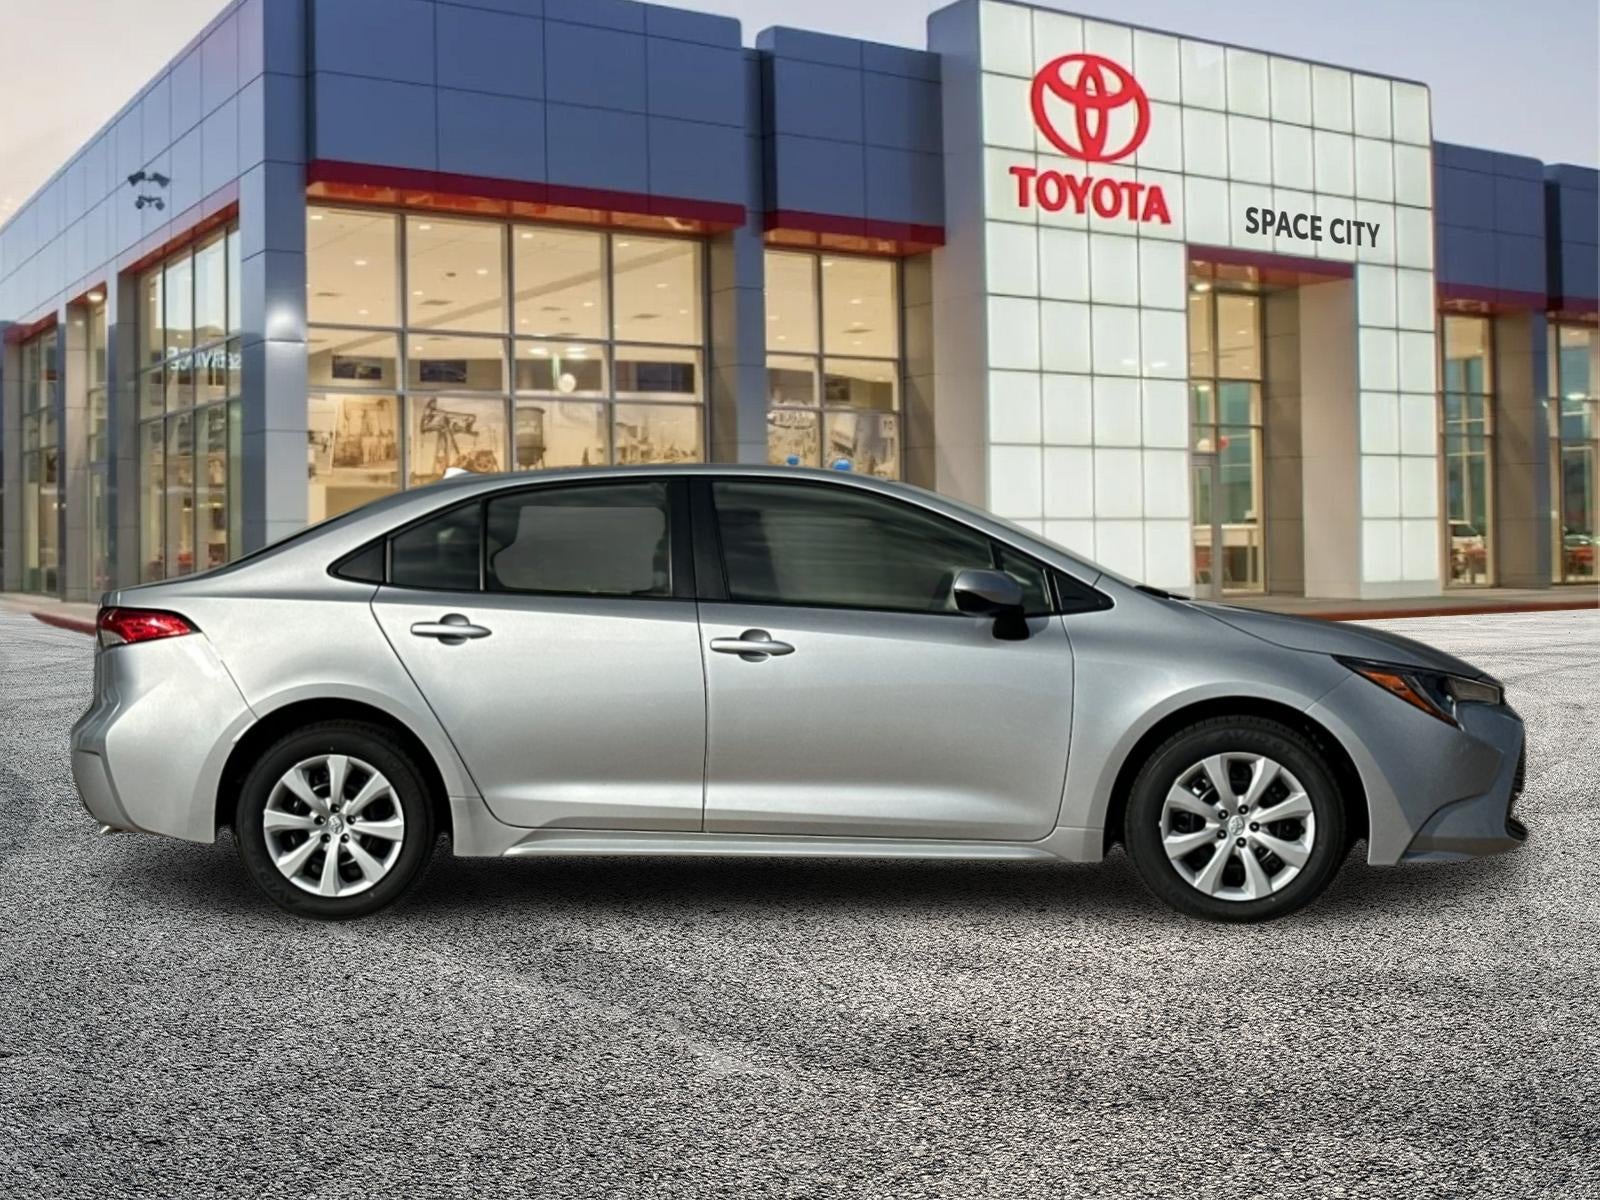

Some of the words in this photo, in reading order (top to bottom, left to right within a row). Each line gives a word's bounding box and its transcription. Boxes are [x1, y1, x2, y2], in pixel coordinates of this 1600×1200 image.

[1009, 166, 1171, 224] TOYOTA
[1245, 206, 1322, 241] SPACE
[1329, 217, 1380, 247] CITY
